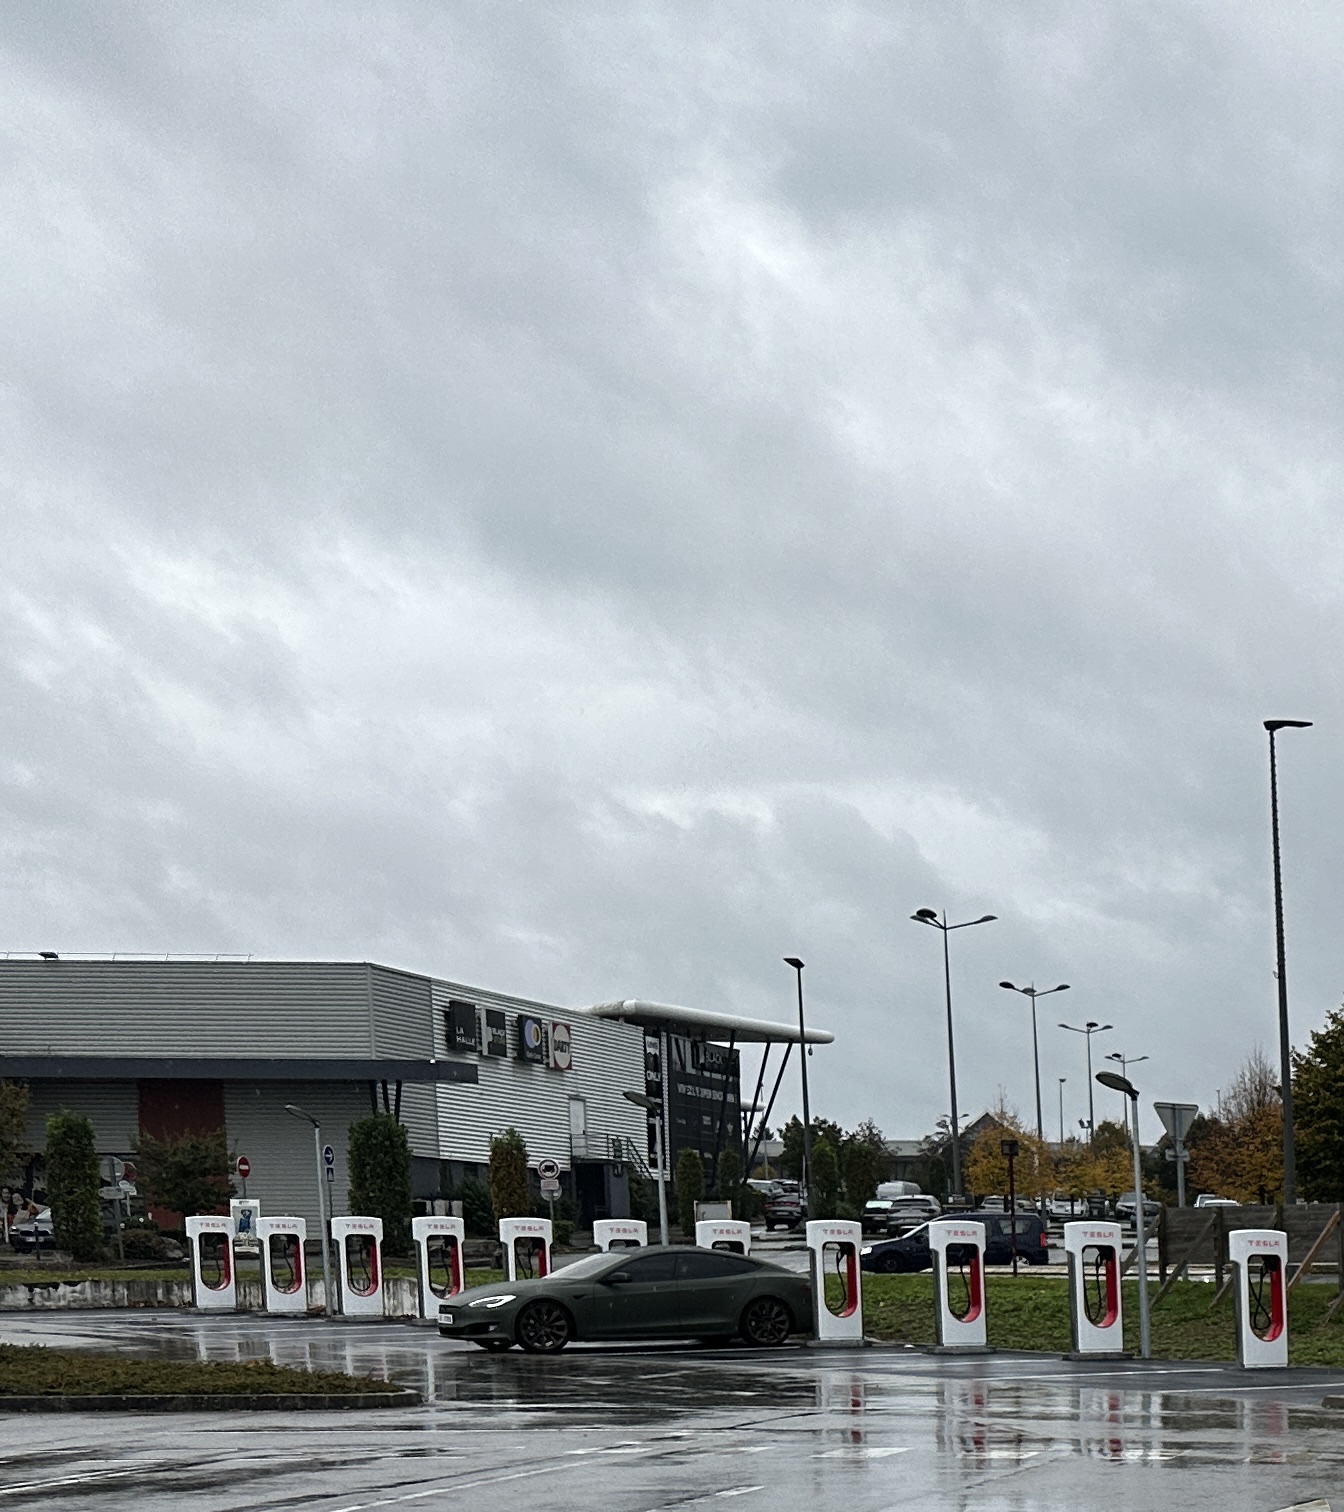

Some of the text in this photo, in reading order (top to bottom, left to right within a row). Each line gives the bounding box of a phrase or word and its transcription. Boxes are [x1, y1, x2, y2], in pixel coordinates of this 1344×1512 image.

[609, 1226, 639, 1234] TESLA
[712, 1227, 742, 1235] TESLA
[821, 1228, 855, 1236] TESLA
[946, 1229, 978, 1237] TESLA
[1081, 1231, 1115, 1239] TESLA
[1248, 1239, 1280, 1248] TESLA
